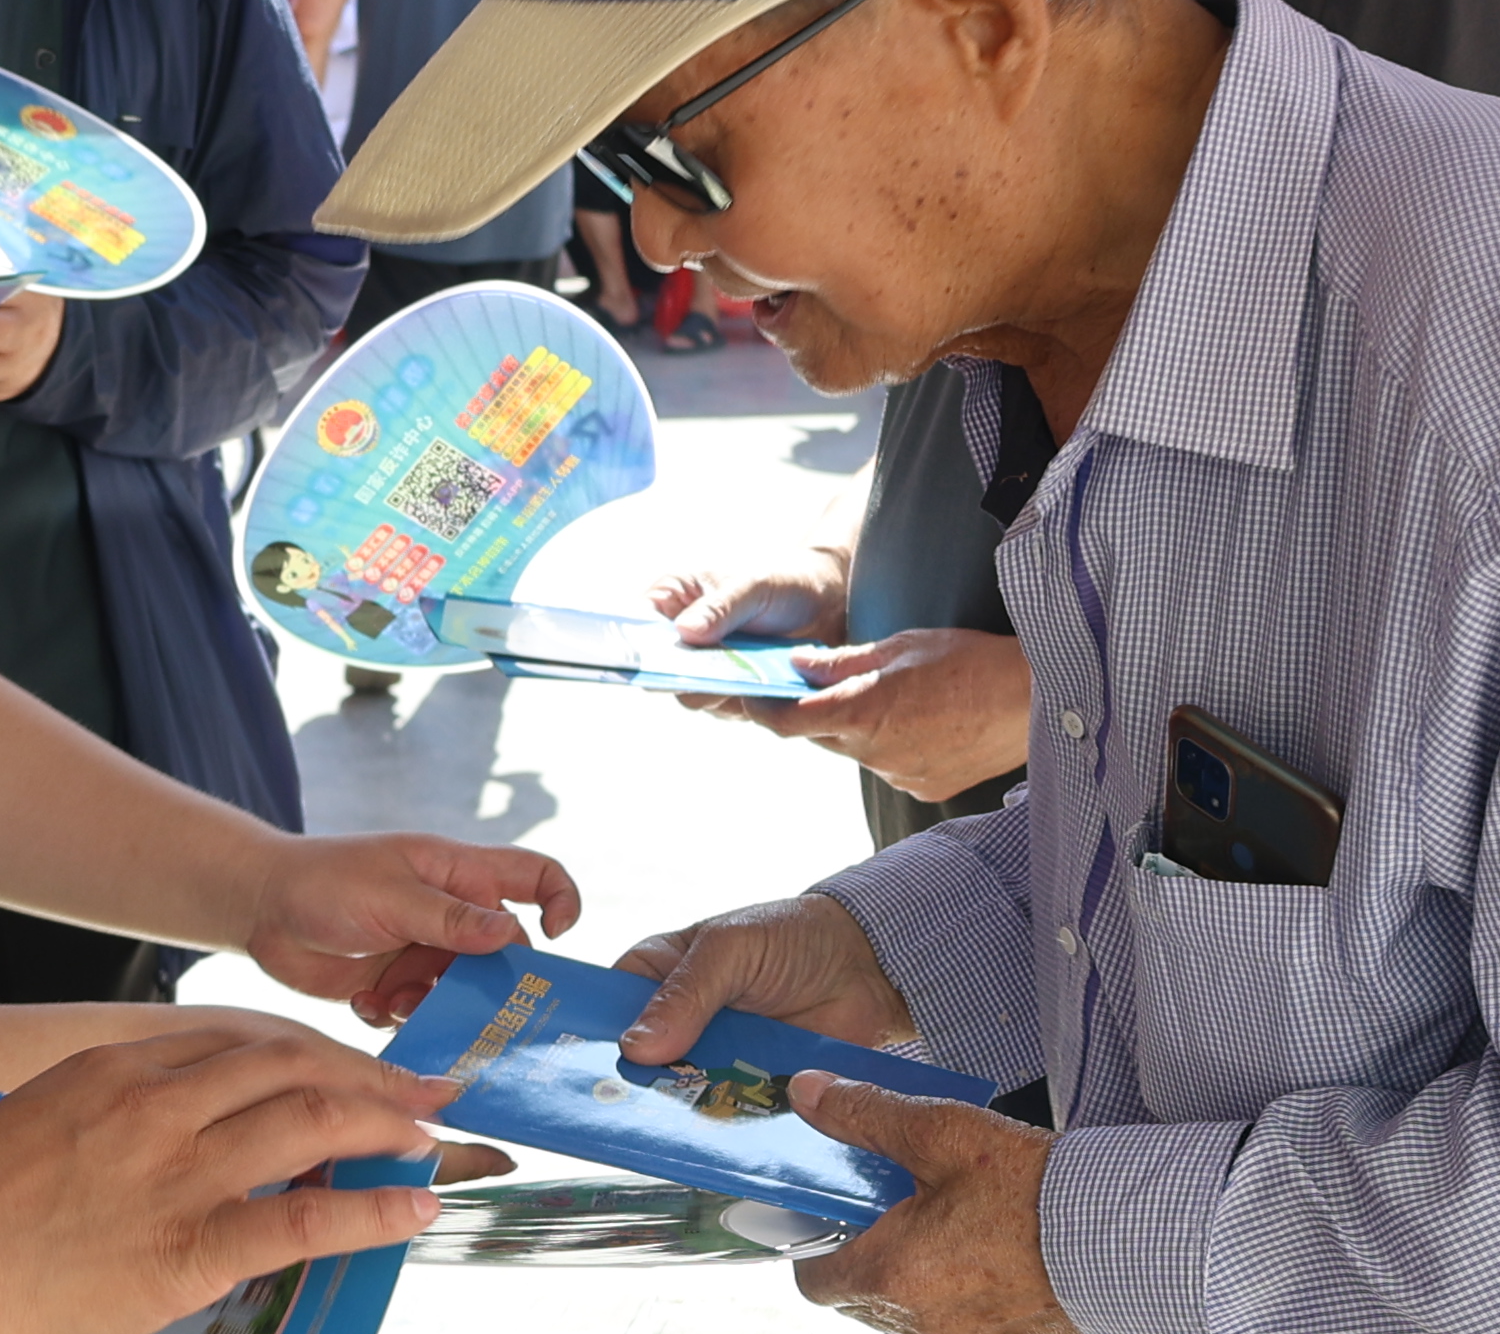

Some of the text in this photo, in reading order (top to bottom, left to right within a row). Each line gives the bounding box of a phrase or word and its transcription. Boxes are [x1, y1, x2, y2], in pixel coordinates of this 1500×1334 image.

[353, 415, 434, 505] 国家反诈中心
